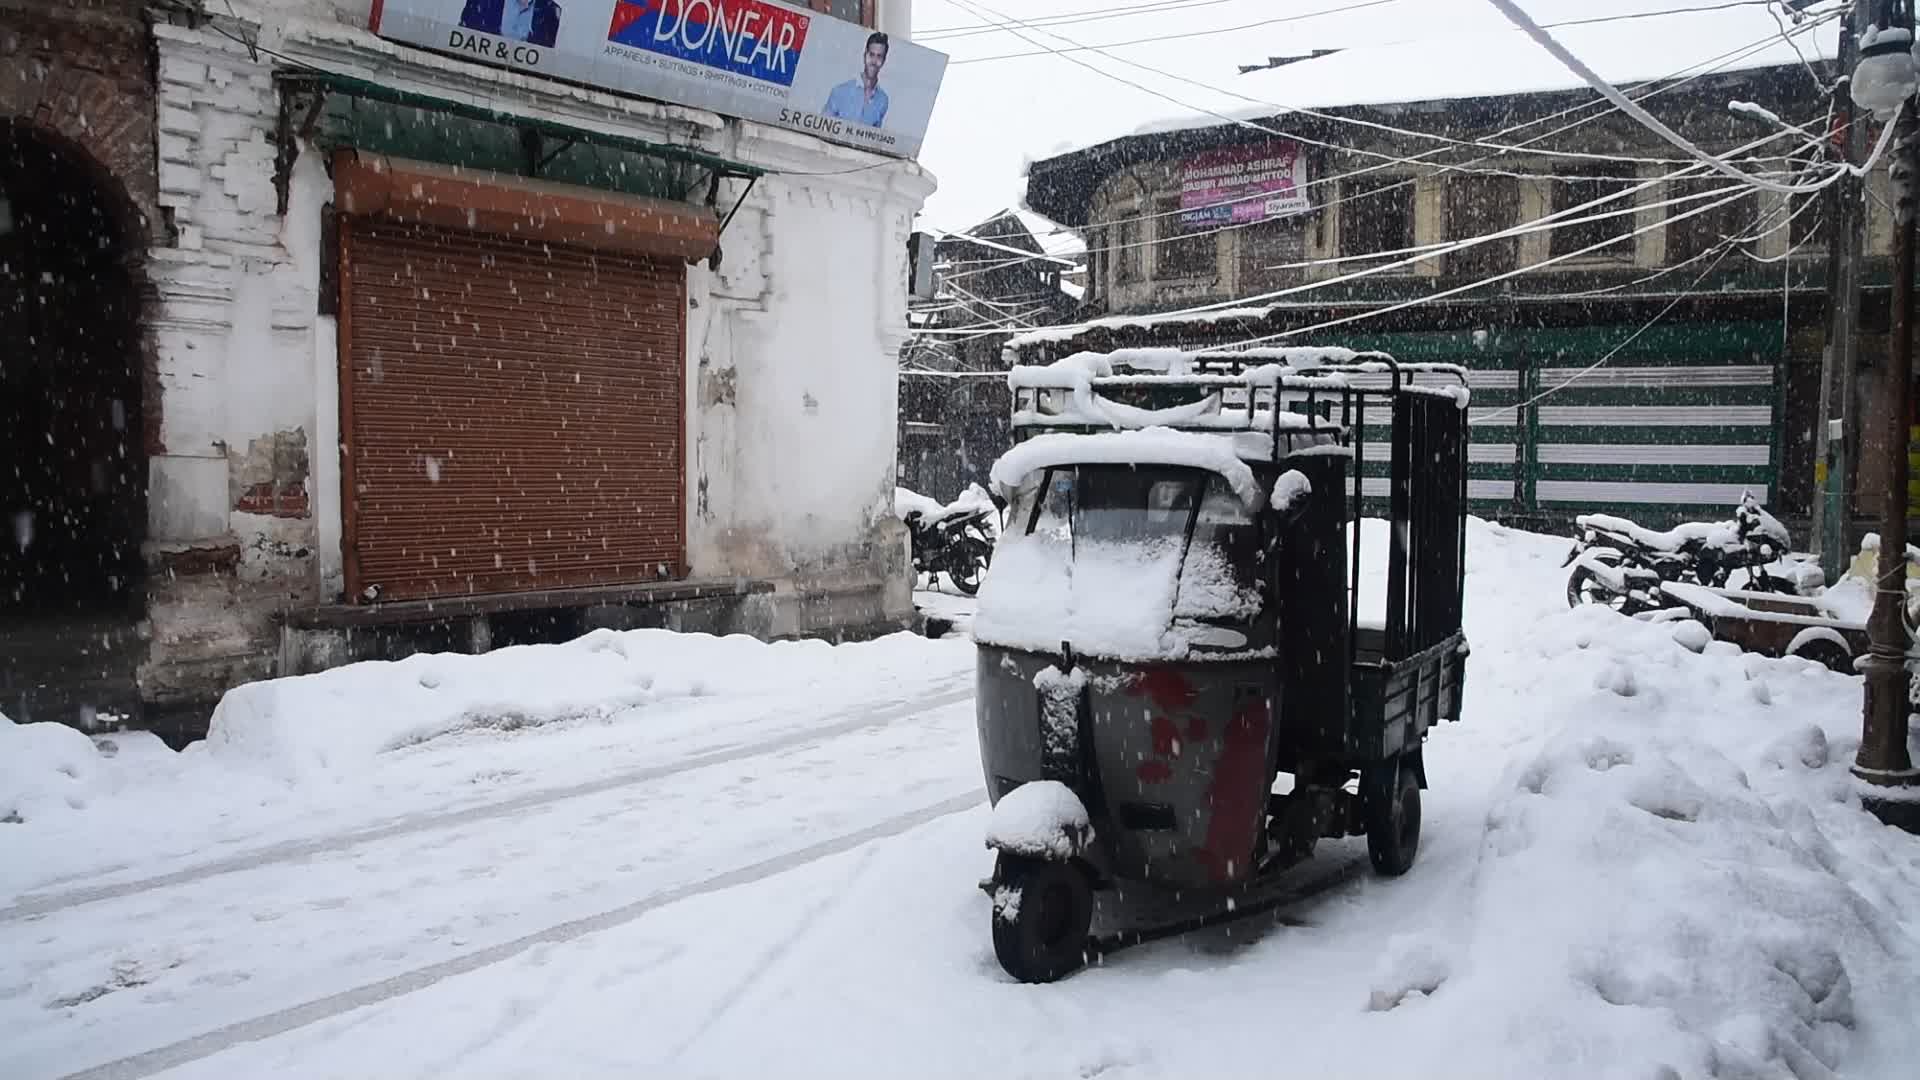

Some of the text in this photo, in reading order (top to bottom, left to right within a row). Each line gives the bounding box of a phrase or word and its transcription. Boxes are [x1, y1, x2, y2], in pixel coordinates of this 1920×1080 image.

[448, 30, 540, 65] DAR & CO
[653, 0, 796, 74] DONEAR
[603, 45, 652, 65] APPARELS
[658, 58, 699, 77] SUITINGS
[703, 69, 749, 89] SHIRTINGS
[779, 108, 802, 126] S.R
[803, 113, 842, 135] GUNG
[1184, 156, 1290, 180] MOHAMMAD ASHRAF
[1218, 174, 1250, 187] AHMAD
[1252, 168, 1291, 183] MATTOO
